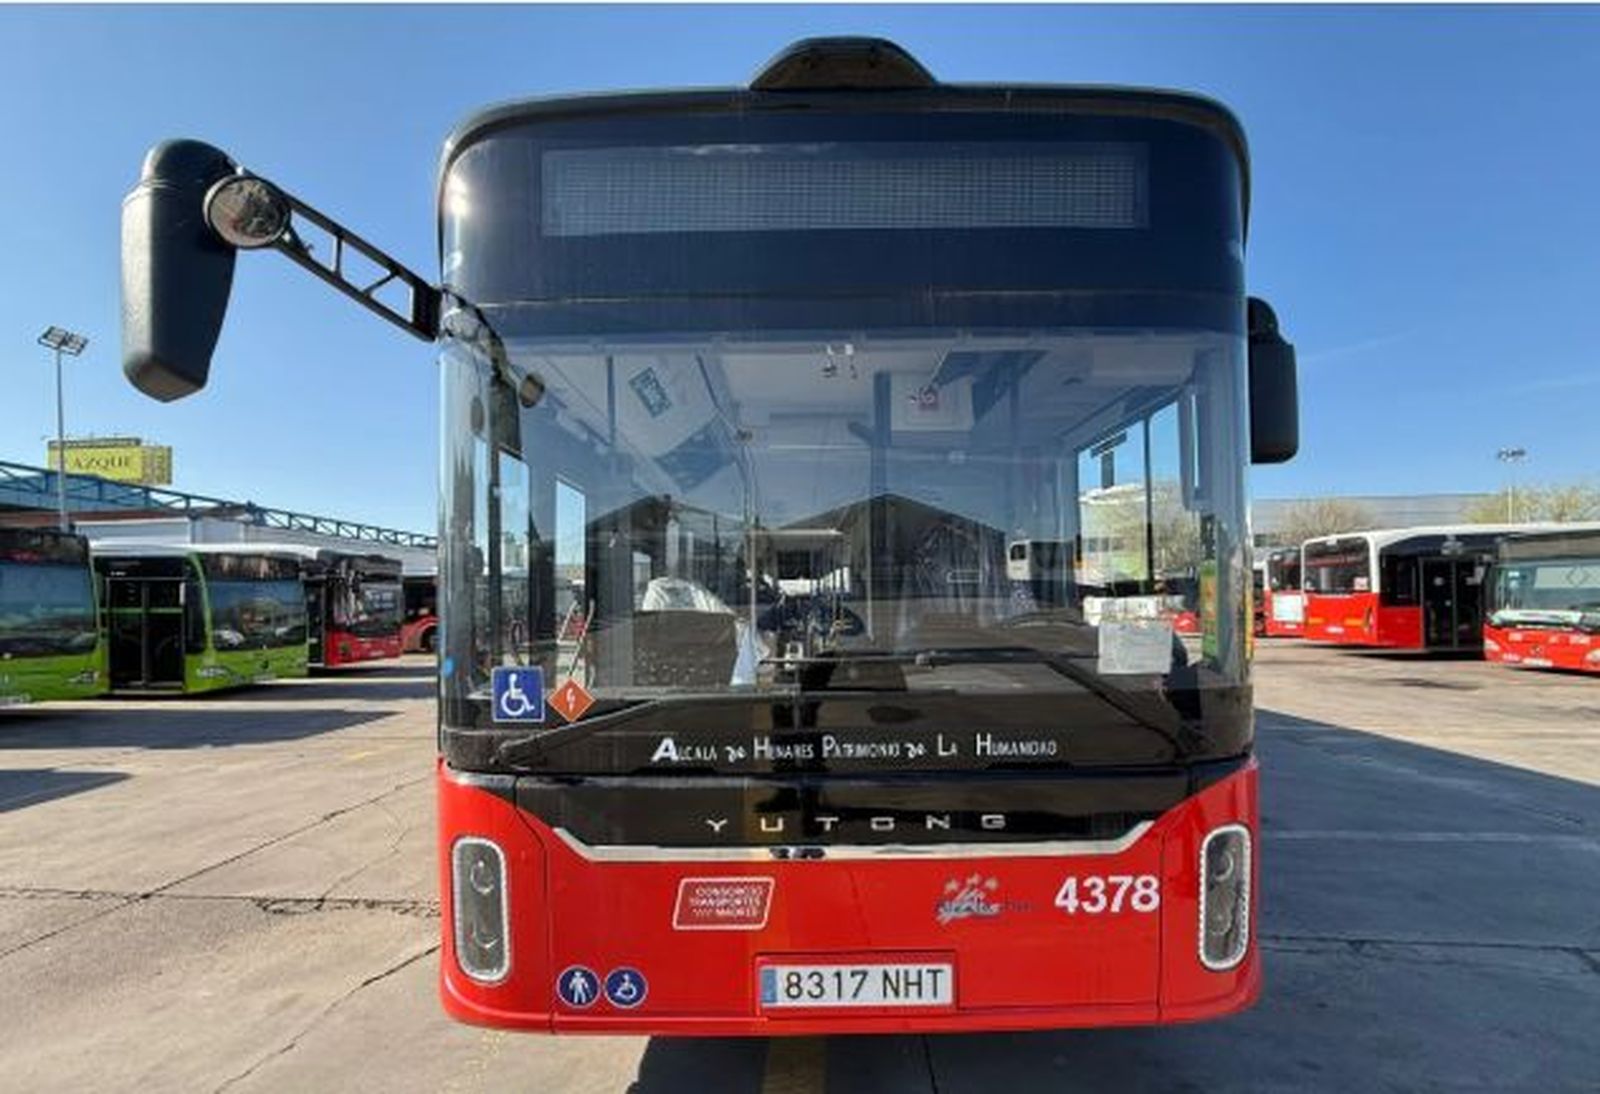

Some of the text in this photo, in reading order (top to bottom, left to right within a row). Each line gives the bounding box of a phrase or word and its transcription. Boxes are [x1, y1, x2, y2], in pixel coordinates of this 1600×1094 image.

[706, 814, 1006, 832] YUTONG
[1054, 874, 1160, 914] 4378
[785, 968, 944, 1000] 8317 NHT
